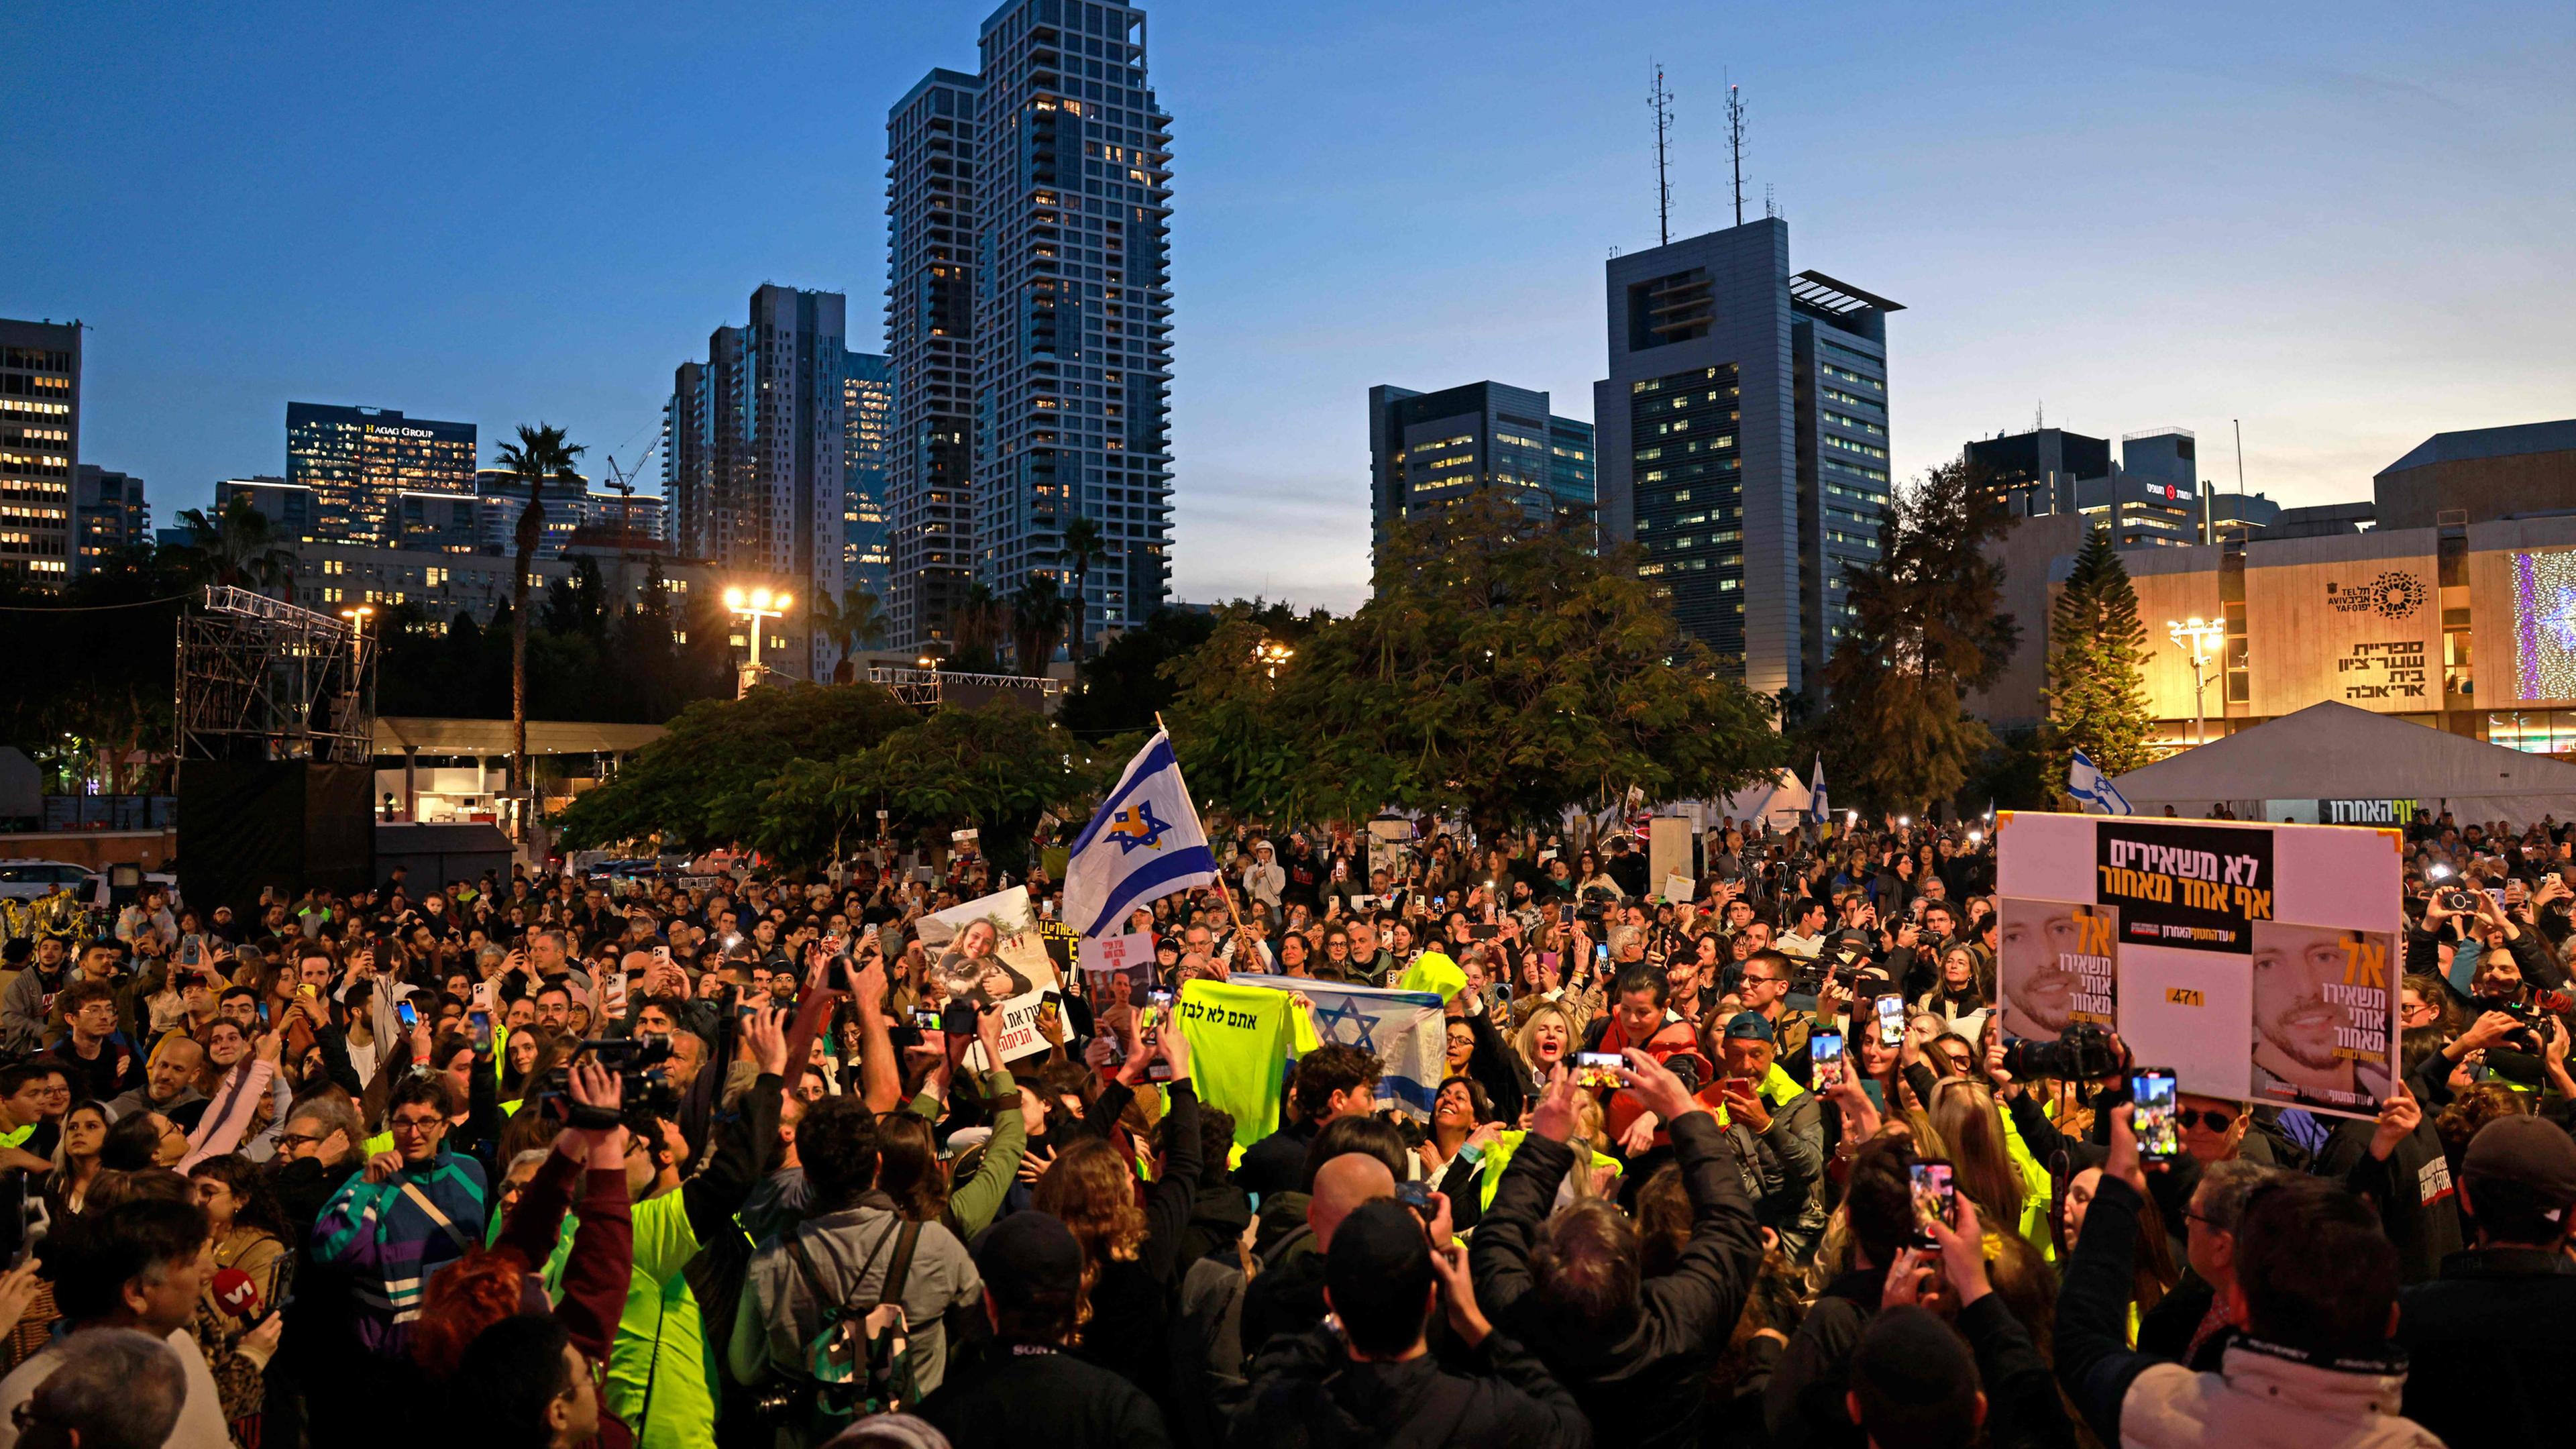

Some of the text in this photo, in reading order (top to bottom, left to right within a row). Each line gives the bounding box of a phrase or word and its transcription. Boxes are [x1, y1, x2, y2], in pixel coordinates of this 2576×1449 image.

[2147, 483, 2165, 495] משפט
[2343, 588, 2357, 596] TEL
[2347, 596, 2371, 604] אביב
[2357, 586, 2370, 595] תל
[2353, 641, 2424, 655] ספריית
[2389, 670, 2425, 682] בית
[2347, 684, 2425, 698] אריאלה
[2110, 839, 2259, 887] לא משאירים
[2098, 865, 2271, 920] אף אחד מאחור
[1038, 921, 1051, 934] LL
[2072, 910, 2111, 956] אל
[2059, 953, 2112, 975] תשאירו
[2339, 936, 2385, 988] אל
[2081, 974, 2112, 995] אותי
[2070, 992, 2112, 1014] מאחור
[2172, 989, 2198, 1006] 471
[2322, 982, 2385, 1010] תשאירו
[1007, 1010, 1024, 1028] את
[1182, 1000, 1257, 1030] אתם לא לבד
[2349, 1007, 2385, 1031] אותי
[2334, 1026, 2385, 1053] מאחור
